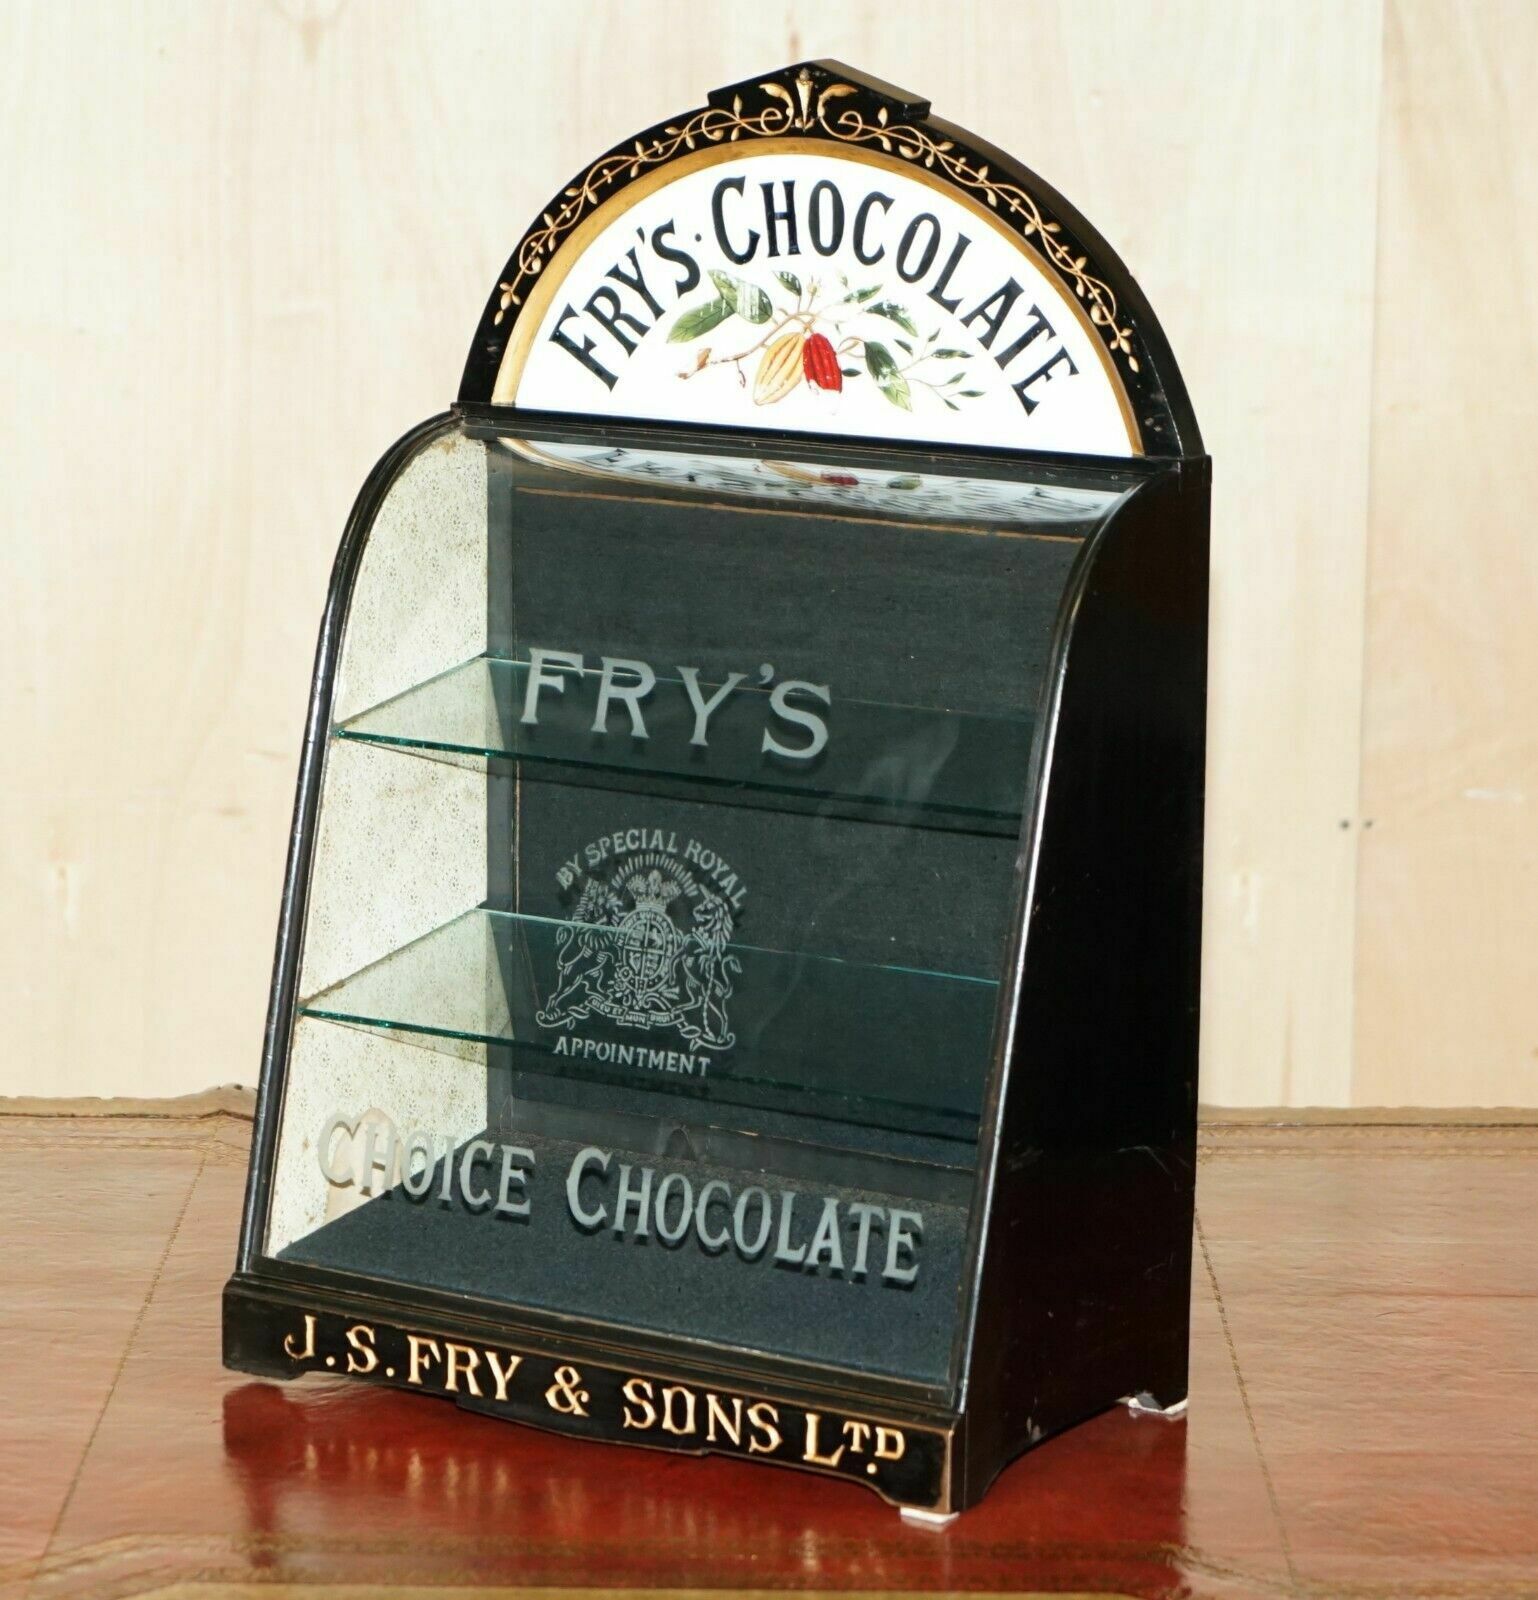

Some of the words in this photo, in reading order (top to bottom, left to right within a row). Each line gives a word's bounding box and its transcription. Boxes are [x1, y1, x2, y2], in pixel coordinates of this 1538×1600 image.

[548, 217, 701, 393] FRY'S
[711, 175, 1080, 417] CHOCOLATE
[520, 647, 832, 759] FRY'S
[556, 855, 582, 890] BY
[585, 828, 678, 867] SPECIAL
[684, 838, 748, 908] ROYAL
[553, 1035, 712, 1077] APPOINTMENT
[317, 1112, 536, 1215] CHOICE
[565, 1146, 924, 1283] CHOCOLATE
[545, 1365, 590, 1417] &
[622, 1378, 783, 1453] SONS
